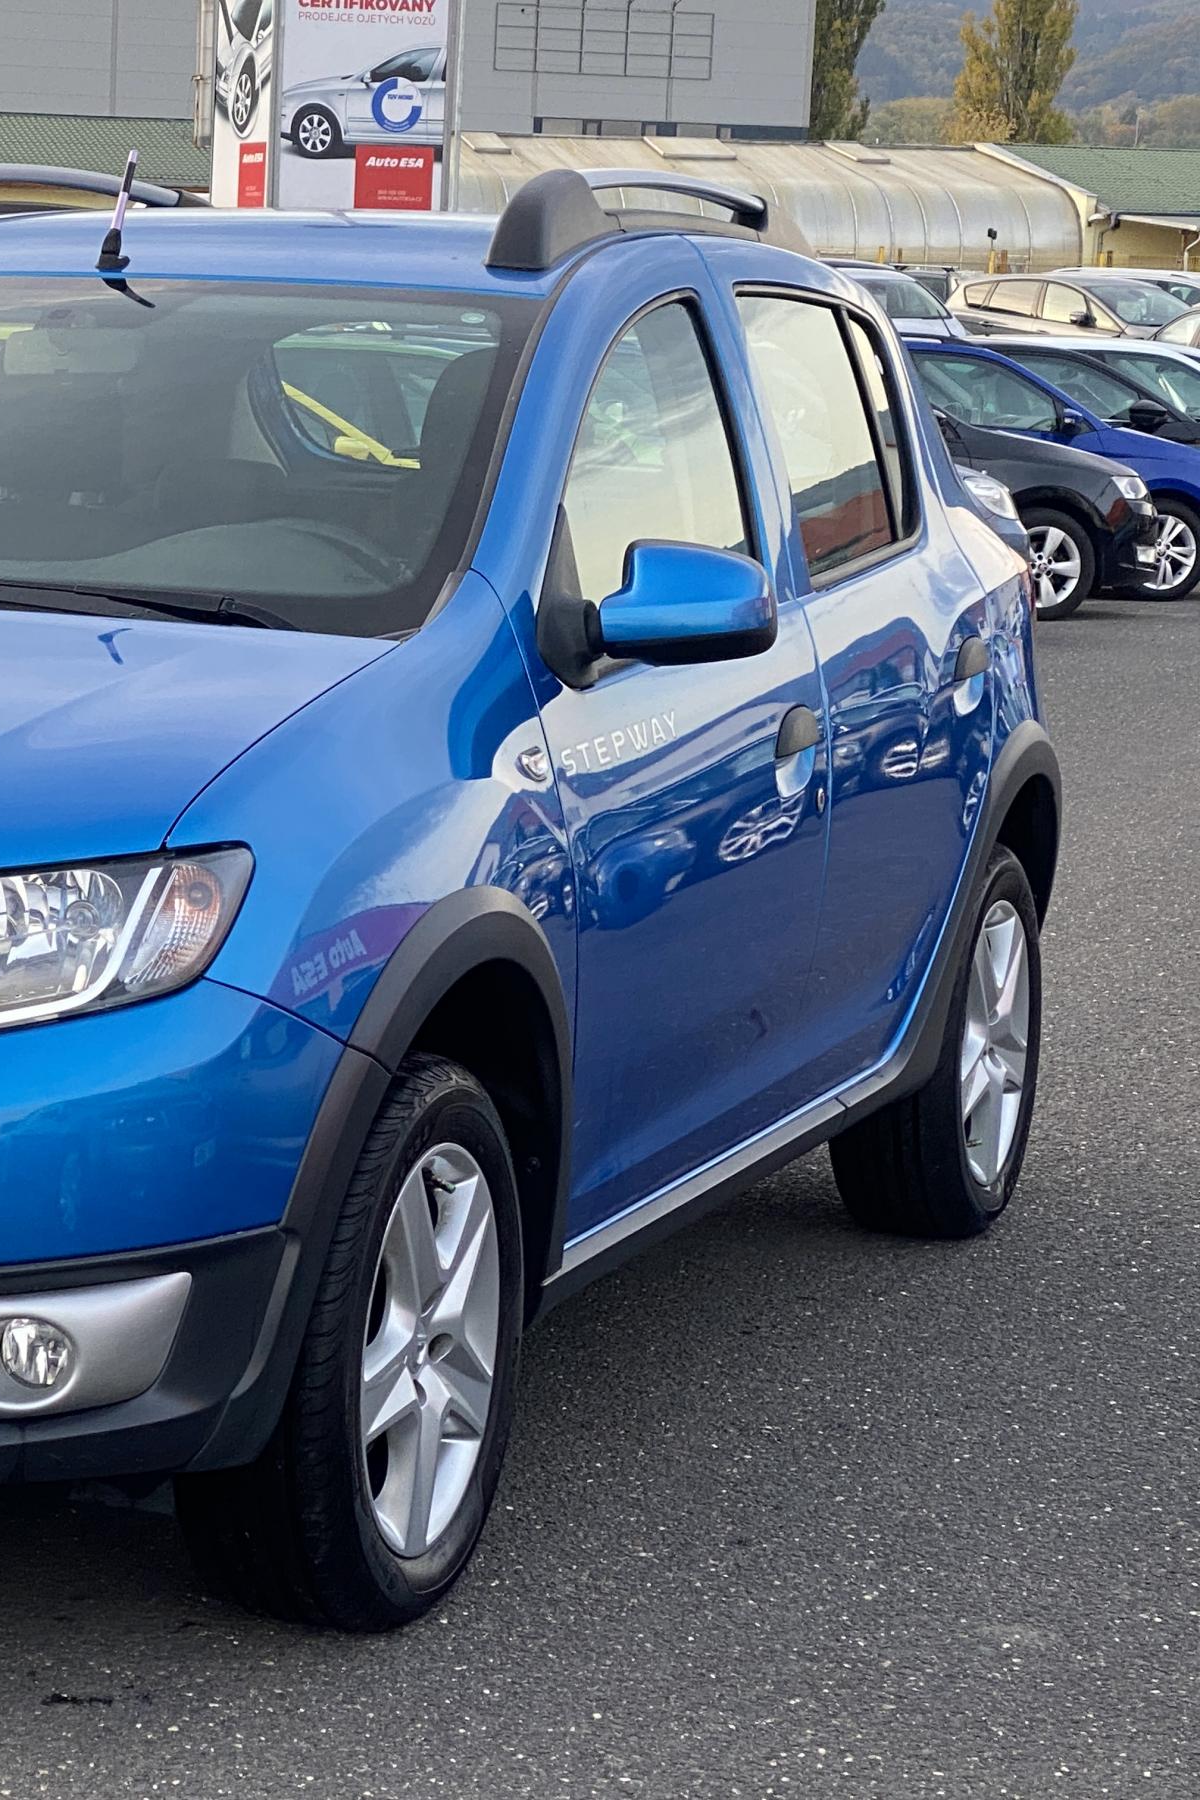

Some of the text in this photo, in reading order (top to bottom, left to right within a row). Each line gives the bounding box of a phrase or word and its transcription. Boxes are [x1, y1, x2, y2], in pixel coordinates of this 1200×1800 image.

[298, 12, 353, 22] PRODEJCE
[365, 156, 424, 168] Auto ESA
[561, 711, 677, 777] STEPWAY
